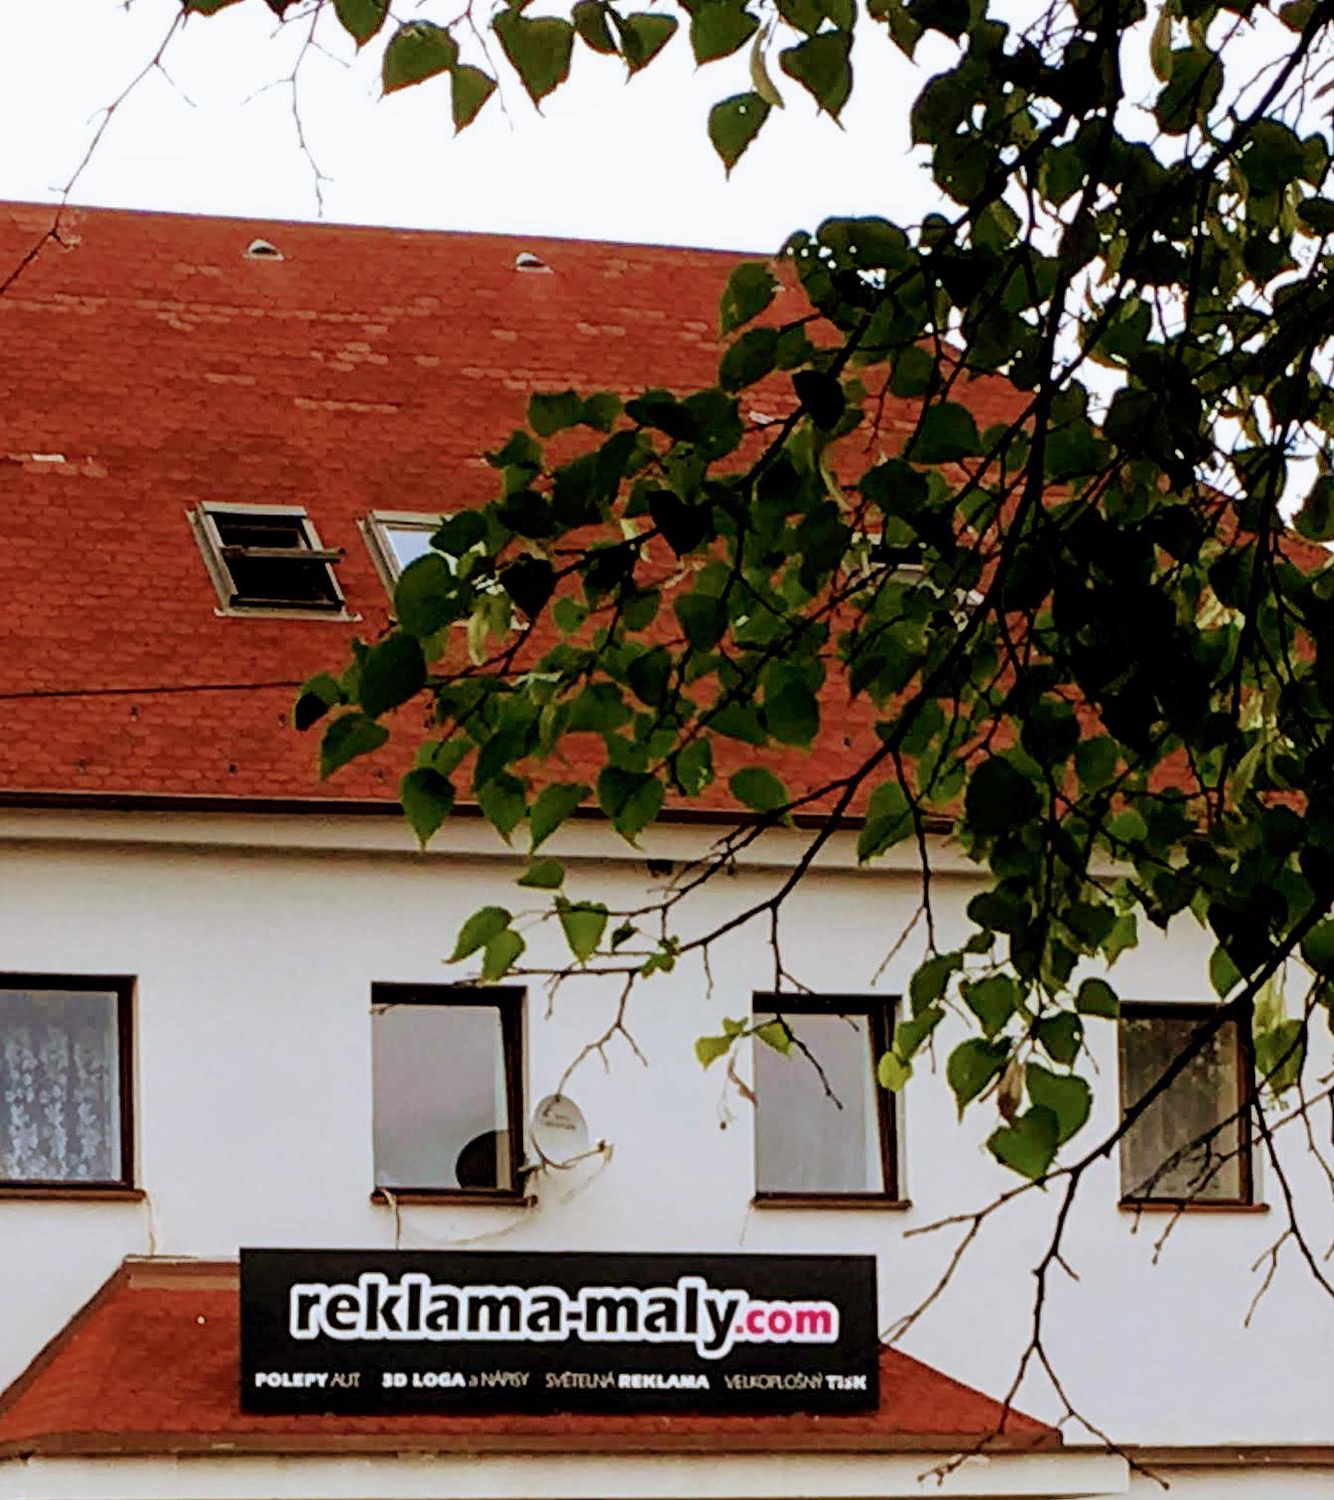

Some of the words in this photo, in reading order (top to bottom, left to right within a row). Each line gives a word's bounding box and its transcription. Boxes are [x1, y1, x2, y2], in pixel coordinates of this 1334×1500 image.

[291, 1274, 838, 1358] reklama-maly.com
[254, 1372, 329, 1388] POLEPY
[330, 1372, 360, 1388] AUT
[382, 1372, 409, 1388] 3D
[412, 1372, 466, 1388] LOGA
[618, 1373, 711, 1389] REKLAMA
